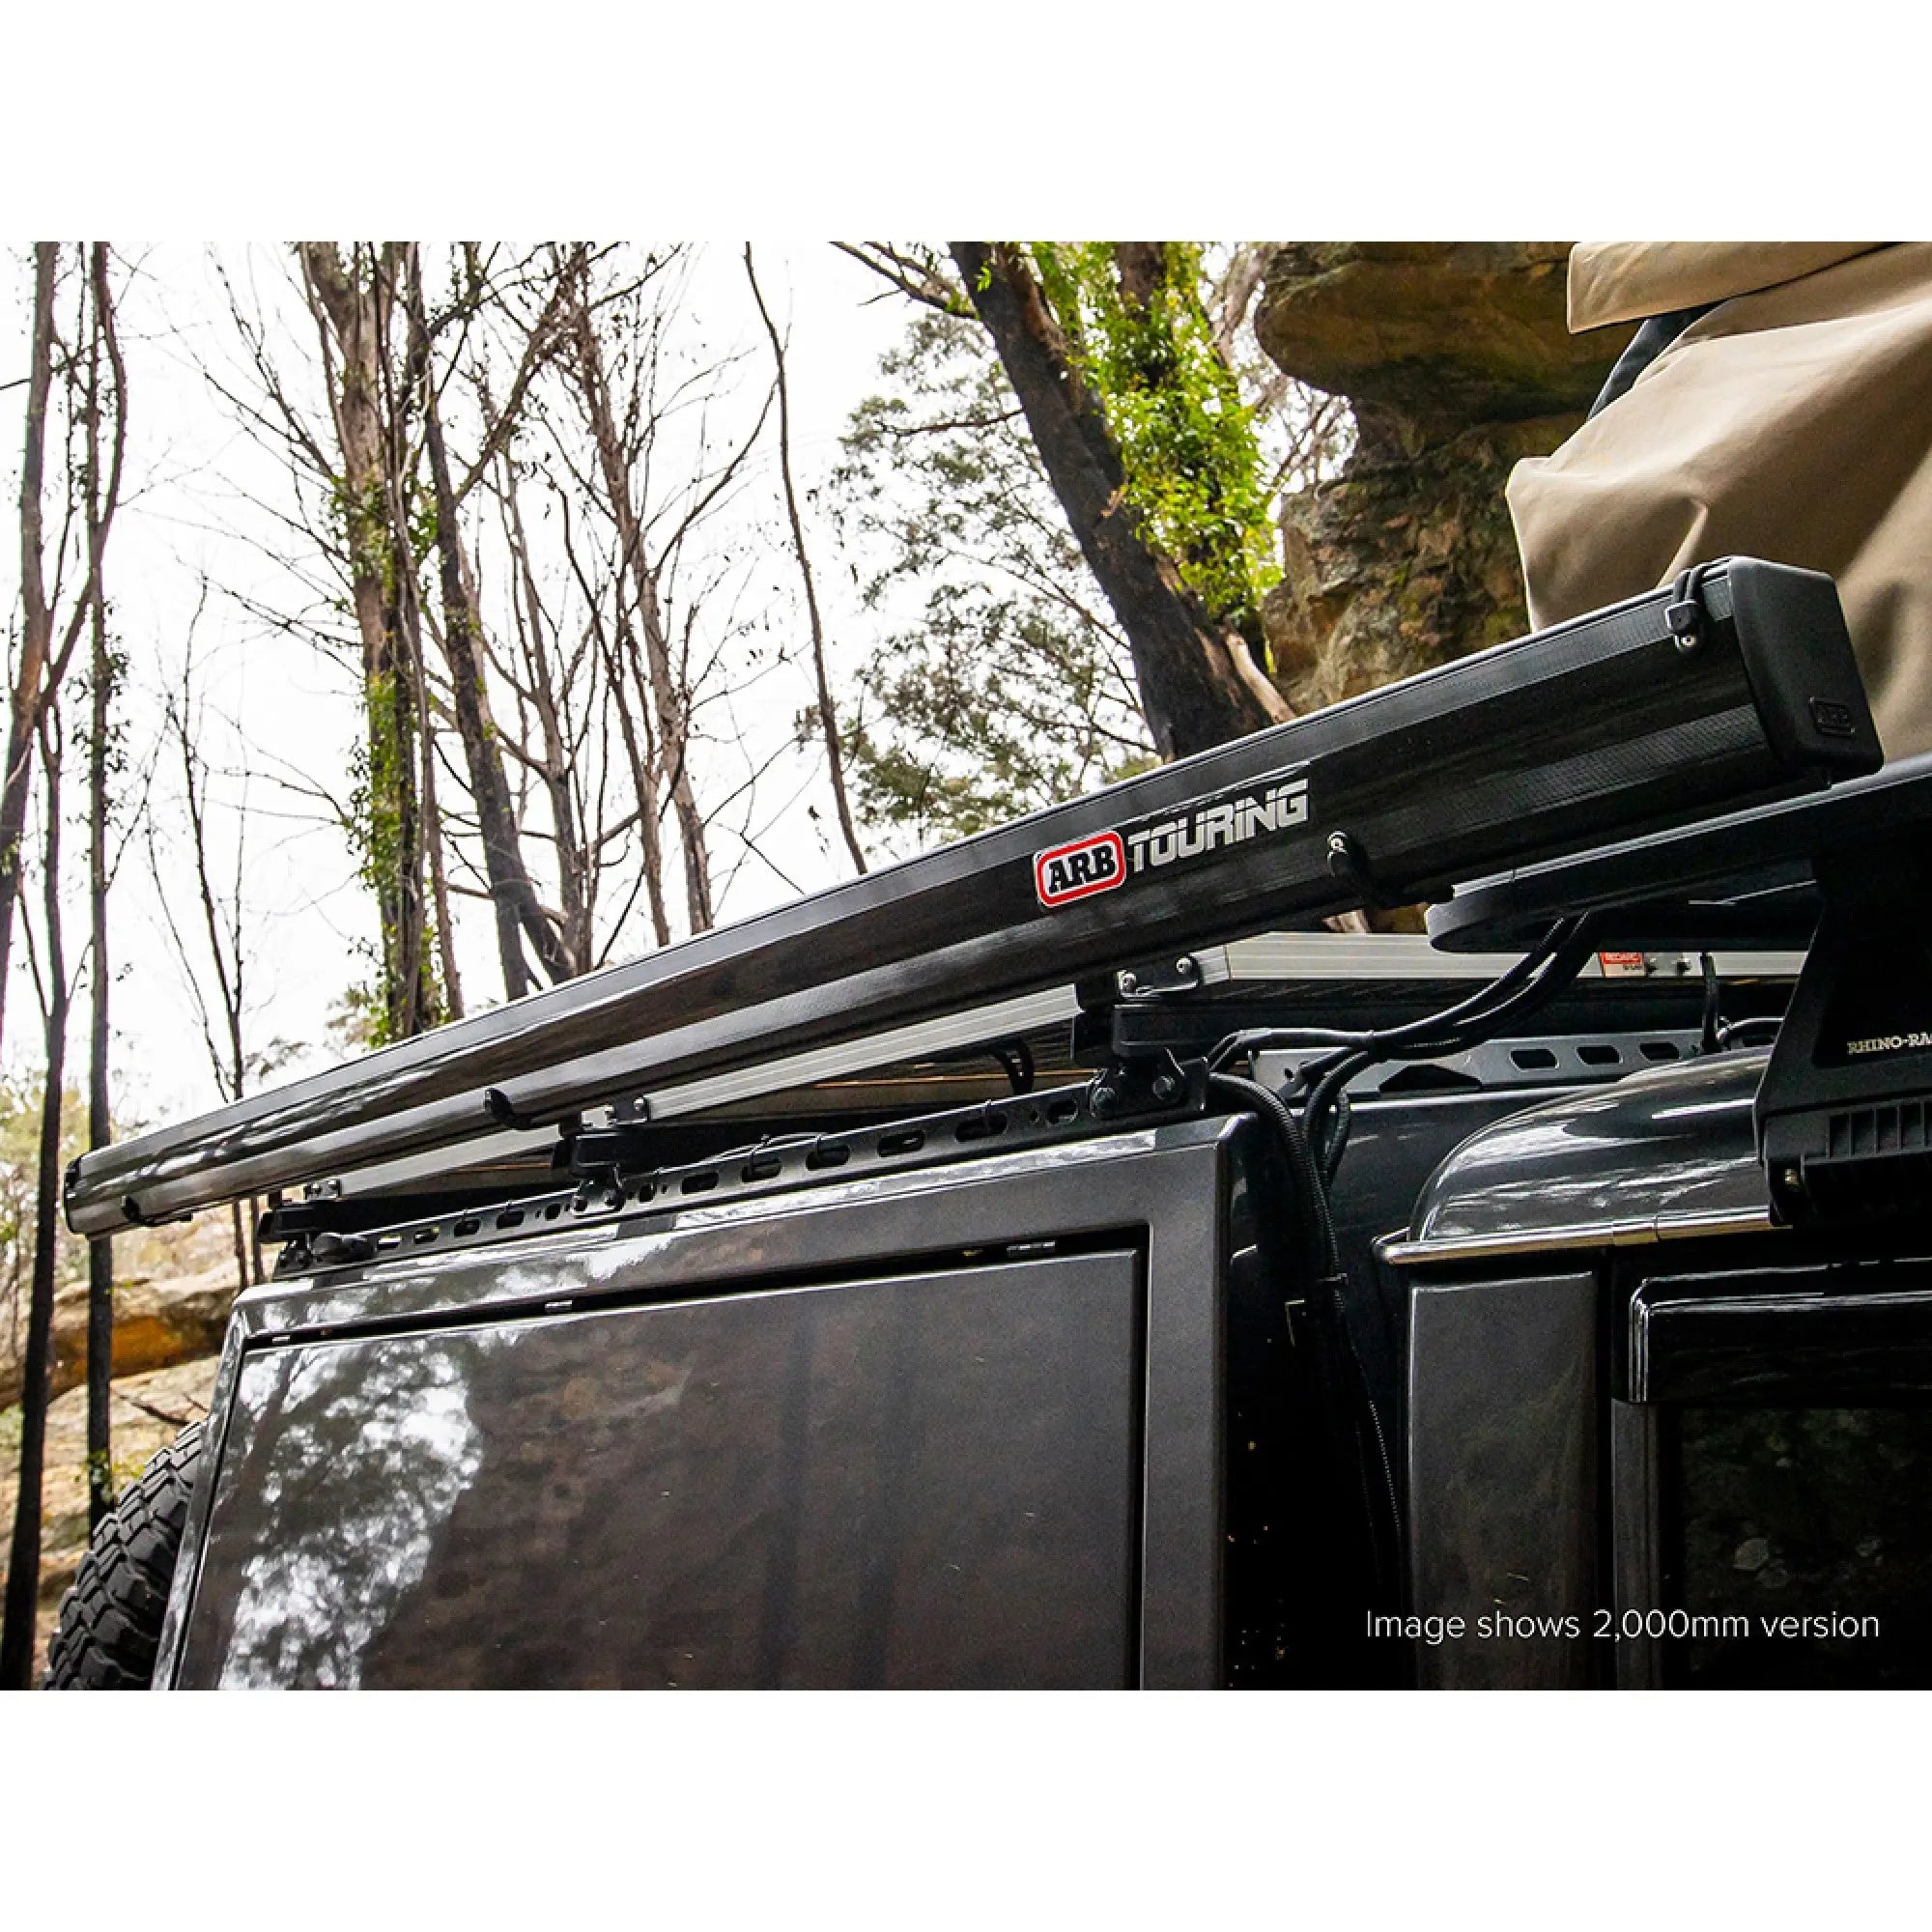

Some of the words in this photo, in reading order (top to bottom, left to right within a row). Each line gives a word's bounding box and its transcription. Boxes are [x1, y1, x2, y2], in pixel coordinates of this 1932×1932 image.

[1047, 843, 1117, 895] ARB
[1127, 779, 1308, 873] TOURING
[1847, 1032, 1932, 1055] RHINO-RA
